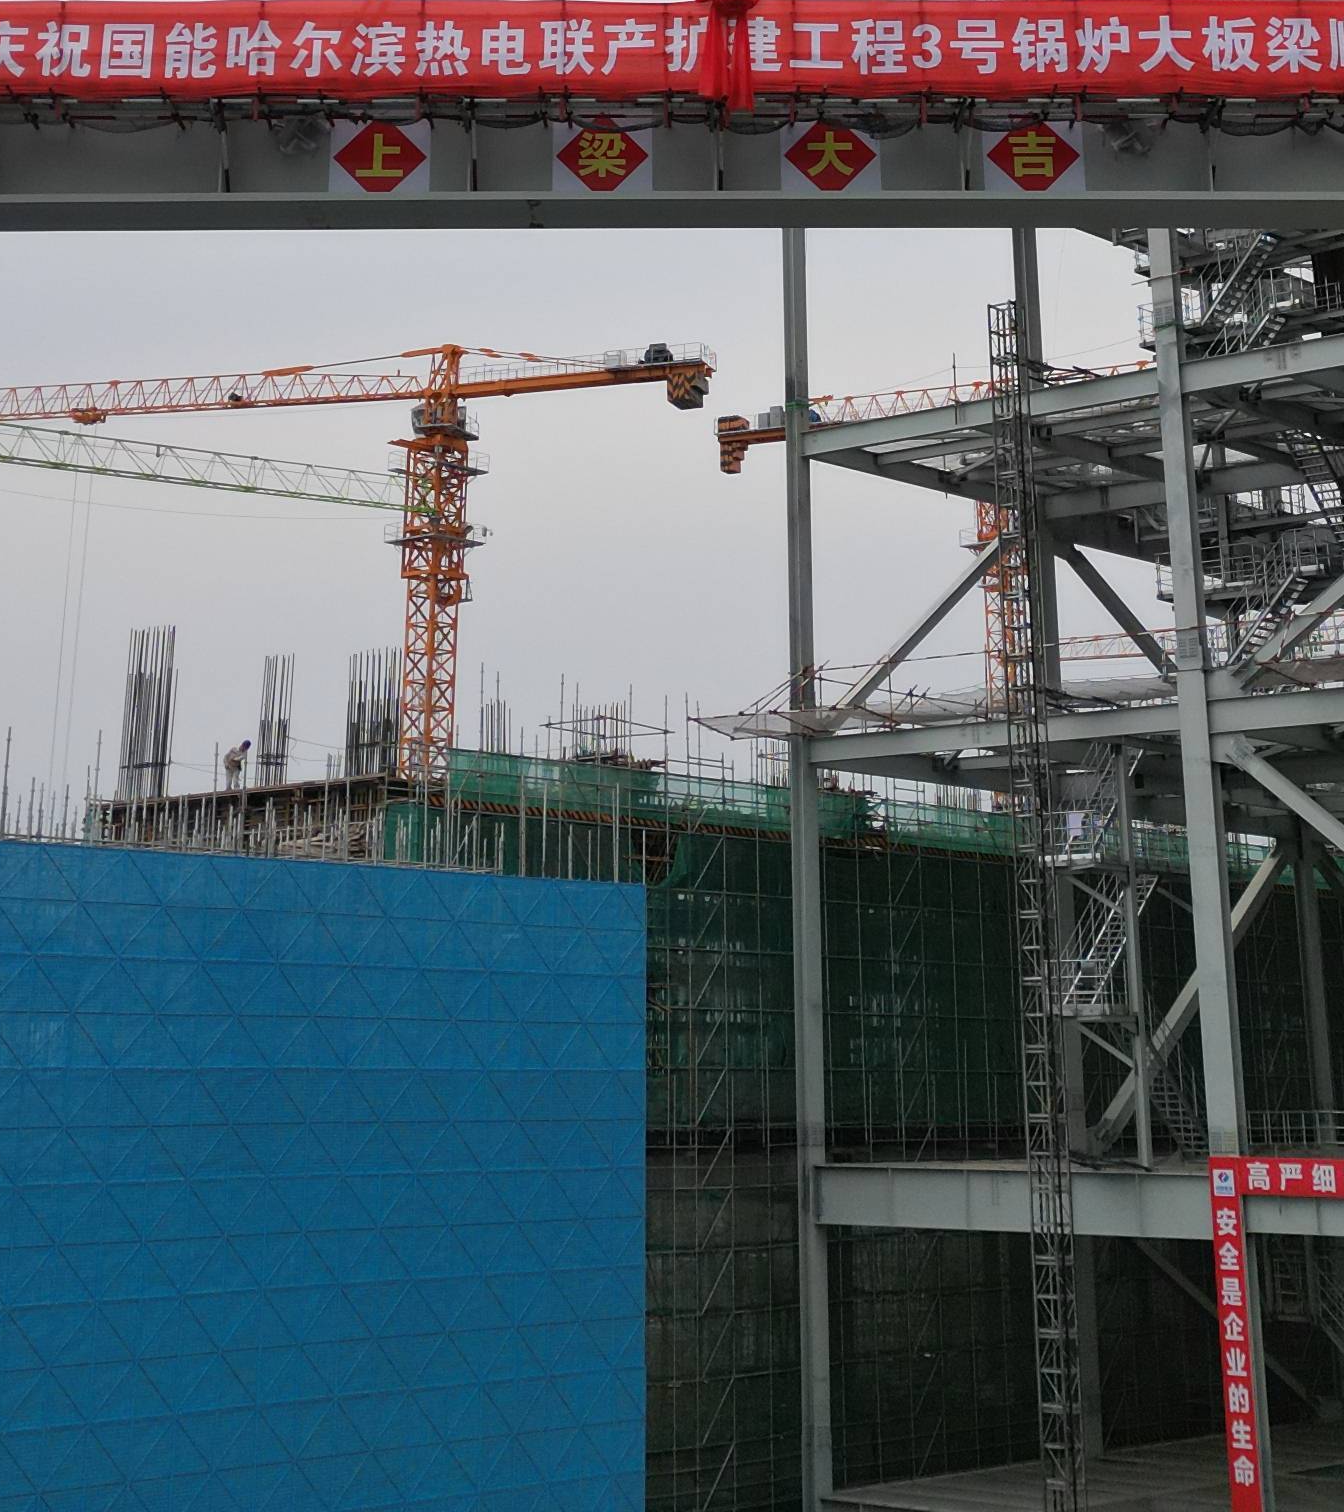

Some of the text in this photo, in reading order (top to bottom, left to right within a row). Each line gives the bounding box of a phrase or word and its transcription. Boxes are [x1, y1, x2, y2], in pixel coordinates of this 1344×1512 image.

[355, 128, 1056, 178] 上梁大吉
[1216, 1207, 1256, 1488] 安全是企业的生命
